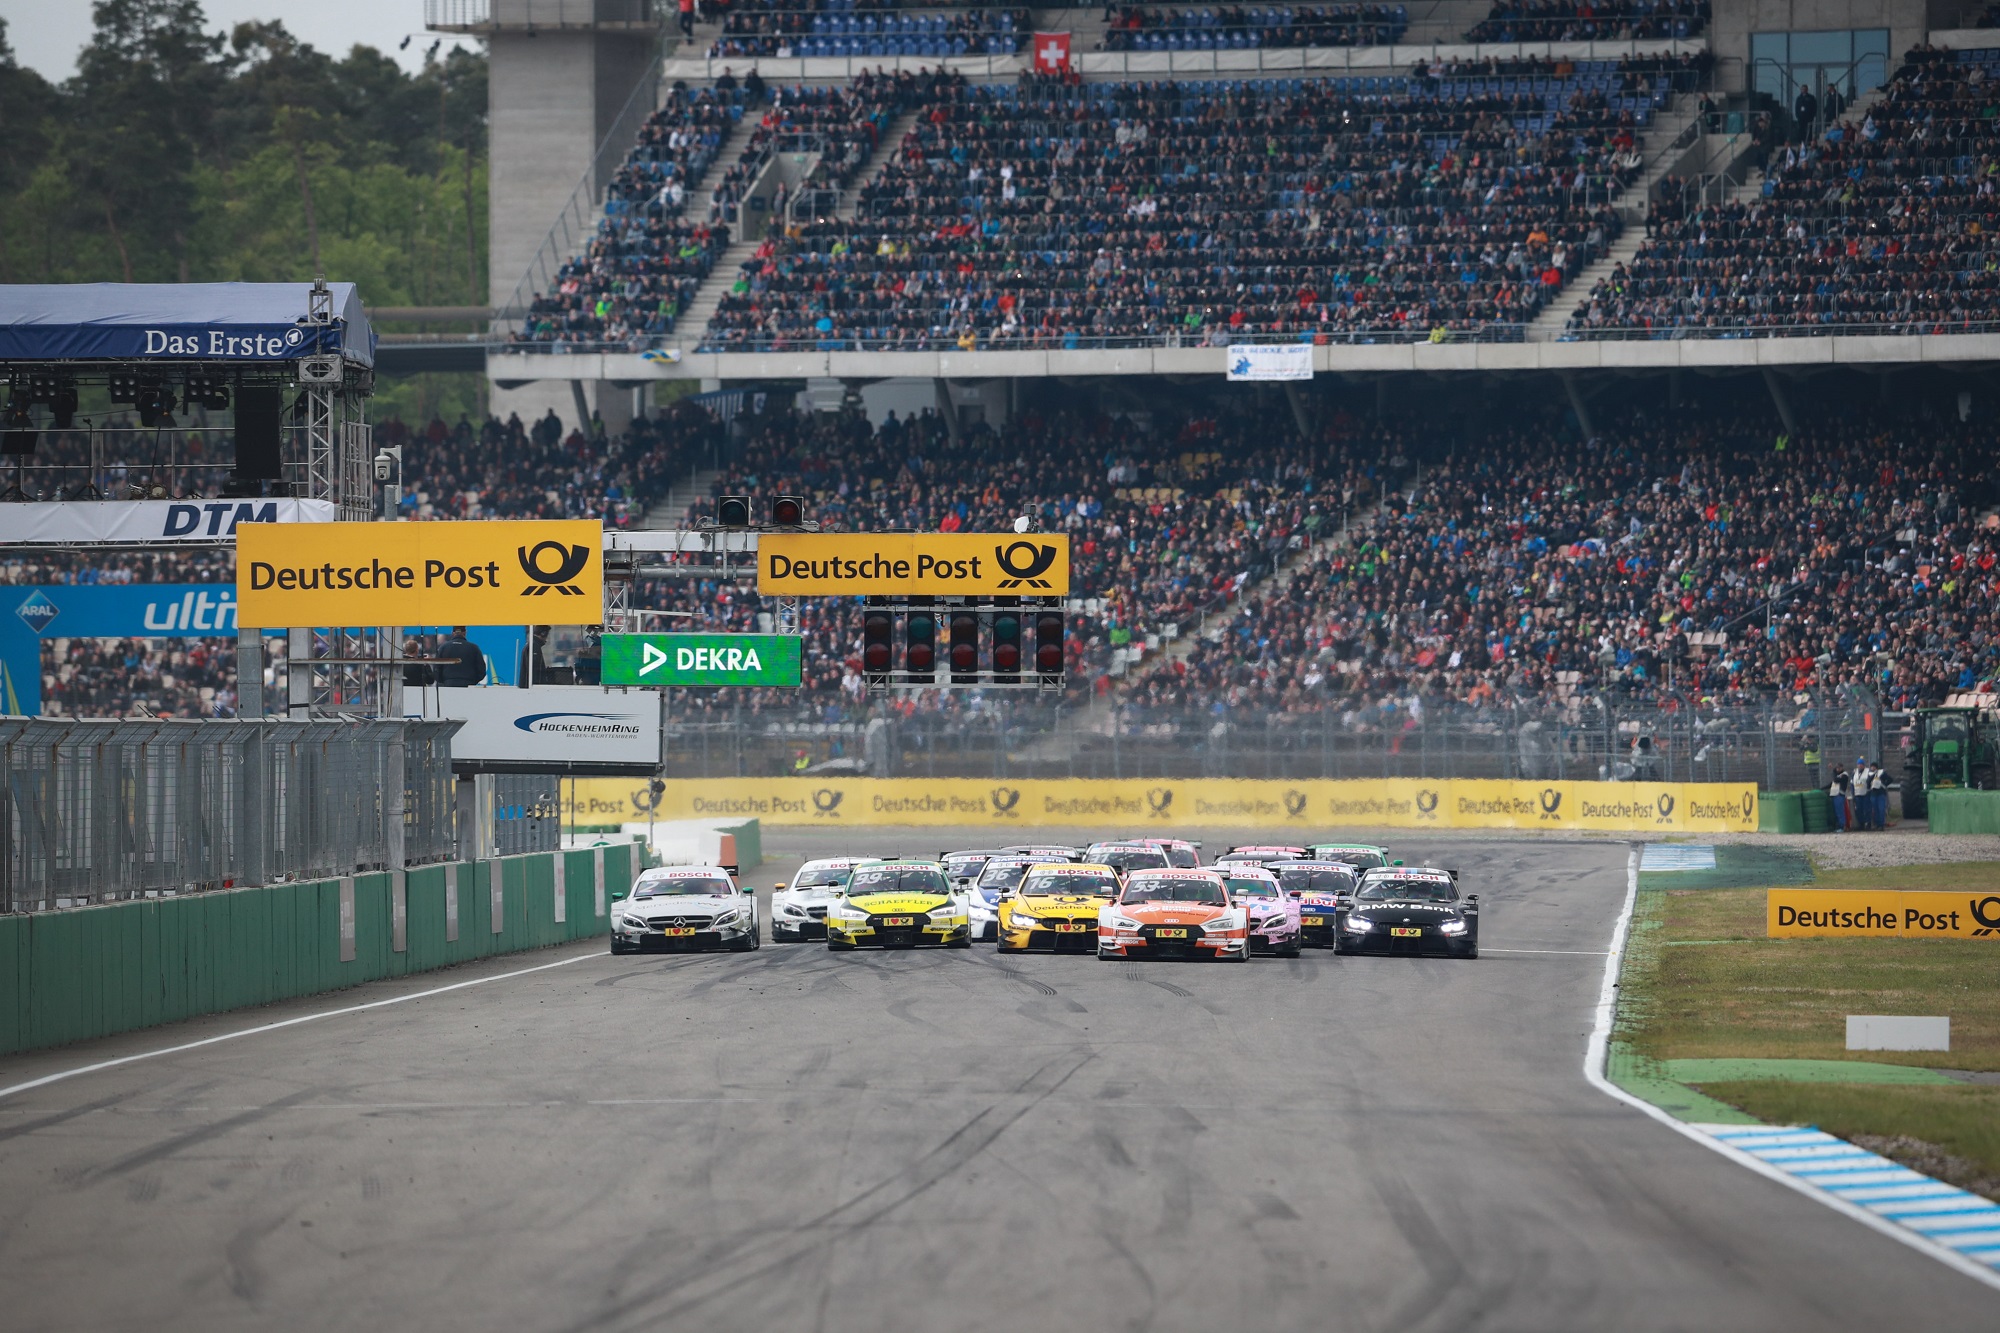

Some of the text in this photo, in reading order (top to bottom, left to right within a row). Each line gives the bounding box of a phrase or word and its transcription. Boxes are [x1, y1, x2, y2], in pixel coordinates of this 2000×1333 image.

[145, 330, 199, 354] Das
[207, 331, 283, 356] Erste
[162, 502, 277, 536] DTM
[770, 553, 982, 579] Deutsche Post
[250, 558, 500, 590] Deutsche Post
[21, 605, 54, 616] ARAL
[677, 648, 762, 671] DEKRA
[589, 798, 624, 813] Post
[693, 797, 807, 814] Deutsche Post
[1582, 801, 1653, 819] Deutsche Post
[1690, 802, 1741, 819] Deutsche Post
[801, 871, 820, 883] 3
[853, 872, 883, 886] 99
[986, 868, 1013, 881] 36
[638, 881, 660, 893] 2
[1029, 876, 1056, 890] 16
[1131, 880, 1160, 893] 53
[1362, 881, 1383, 893] 7
[864, 899, 933, 907] SCHAEFFLER
[1358, 903, 1406, 912] BMW
[1410, 904, 1455, 914] Bank
[1778, 905, 1960, 930] Deutsche Post
